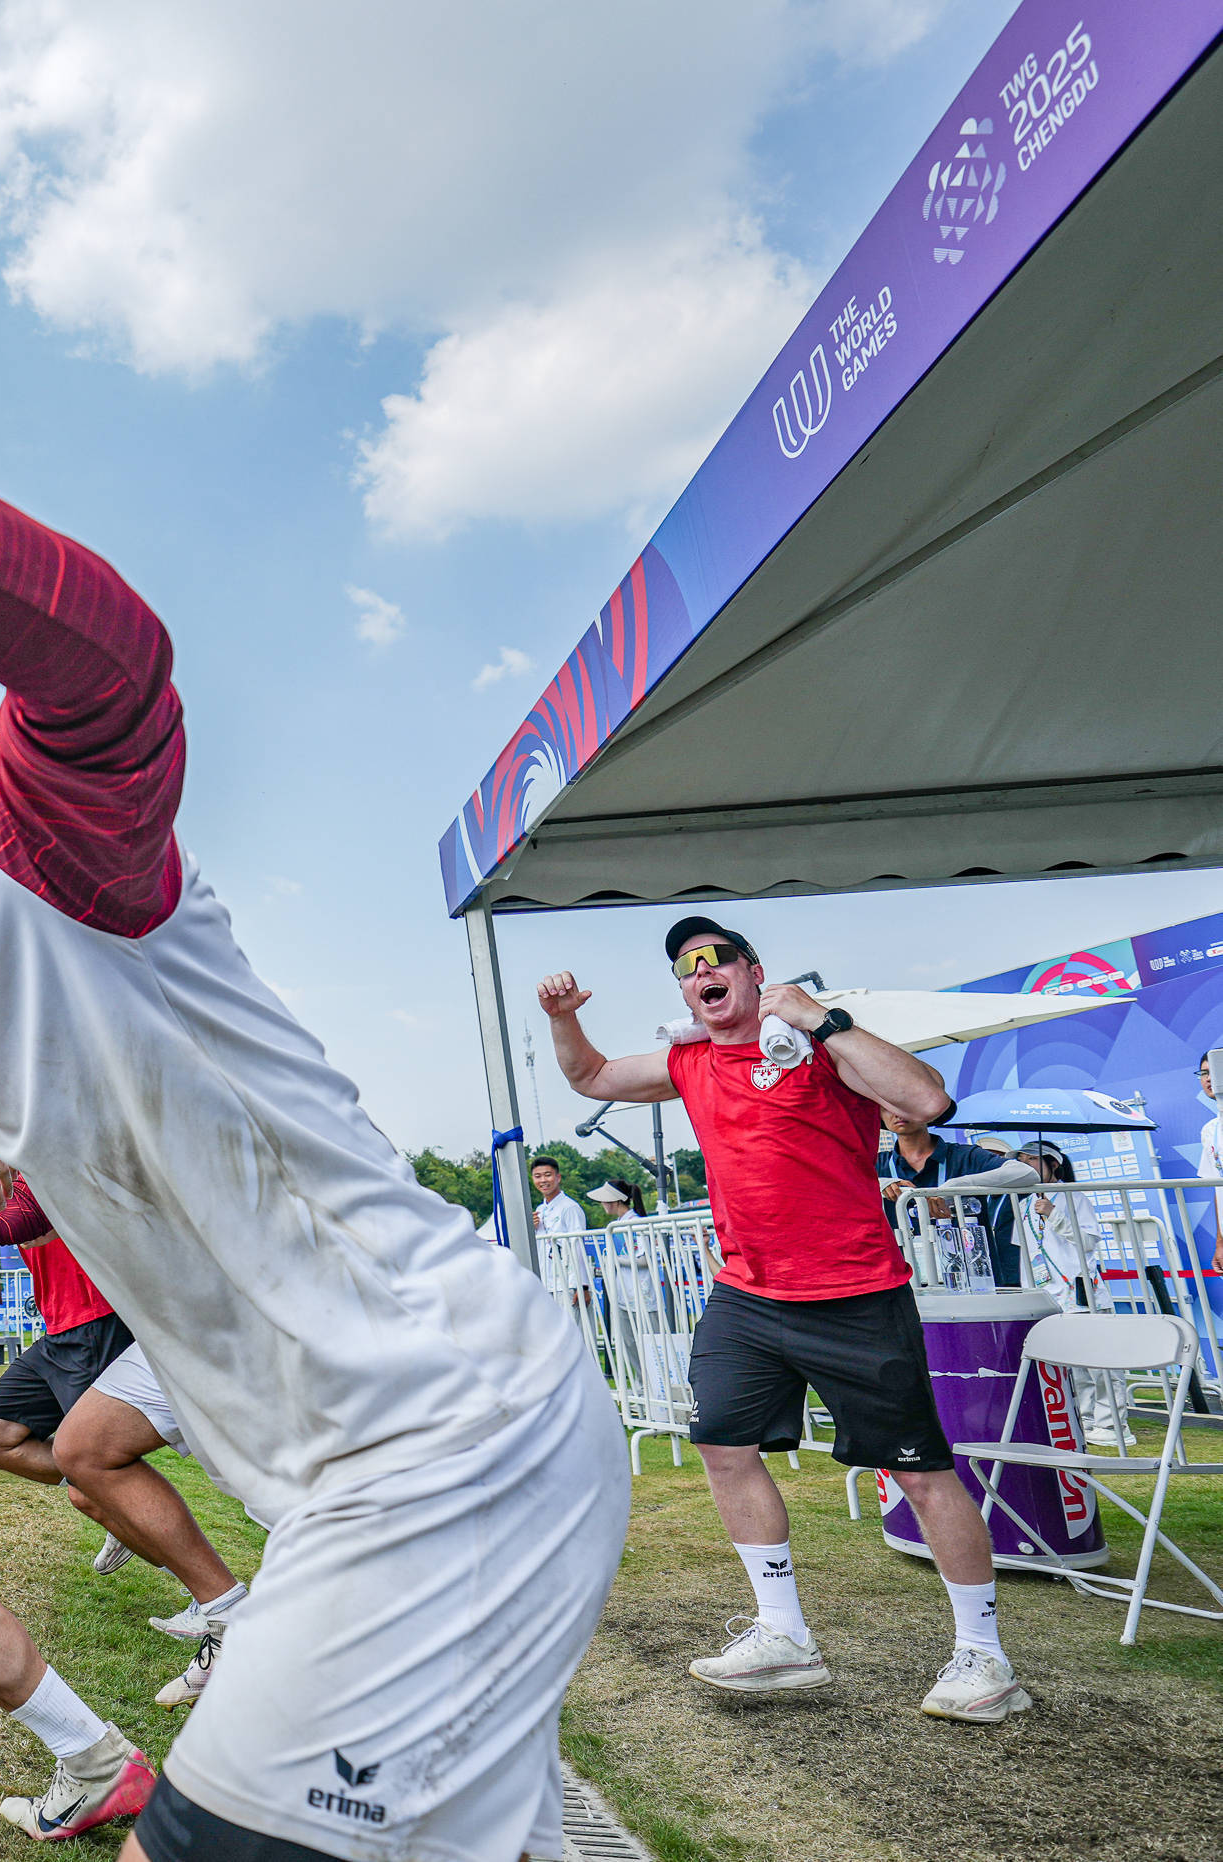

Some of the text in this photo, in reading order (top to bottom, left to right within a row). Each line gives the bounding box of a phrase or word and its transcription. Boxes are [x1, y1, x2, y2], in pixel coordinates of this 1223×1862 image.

[999, 52, 1039, 109] TWG
[1008, 20, 1093, 146] 2025
[1017, 60, 1100, 172] CHENGDU
[828, 294, 860, 345] THE
[834, 285, 893, 368] WORLD
[840, 313, 899, 393] GAMES
[897, 1455, 921, 1463] erima
[306, 1788, 388, 1825] erima
